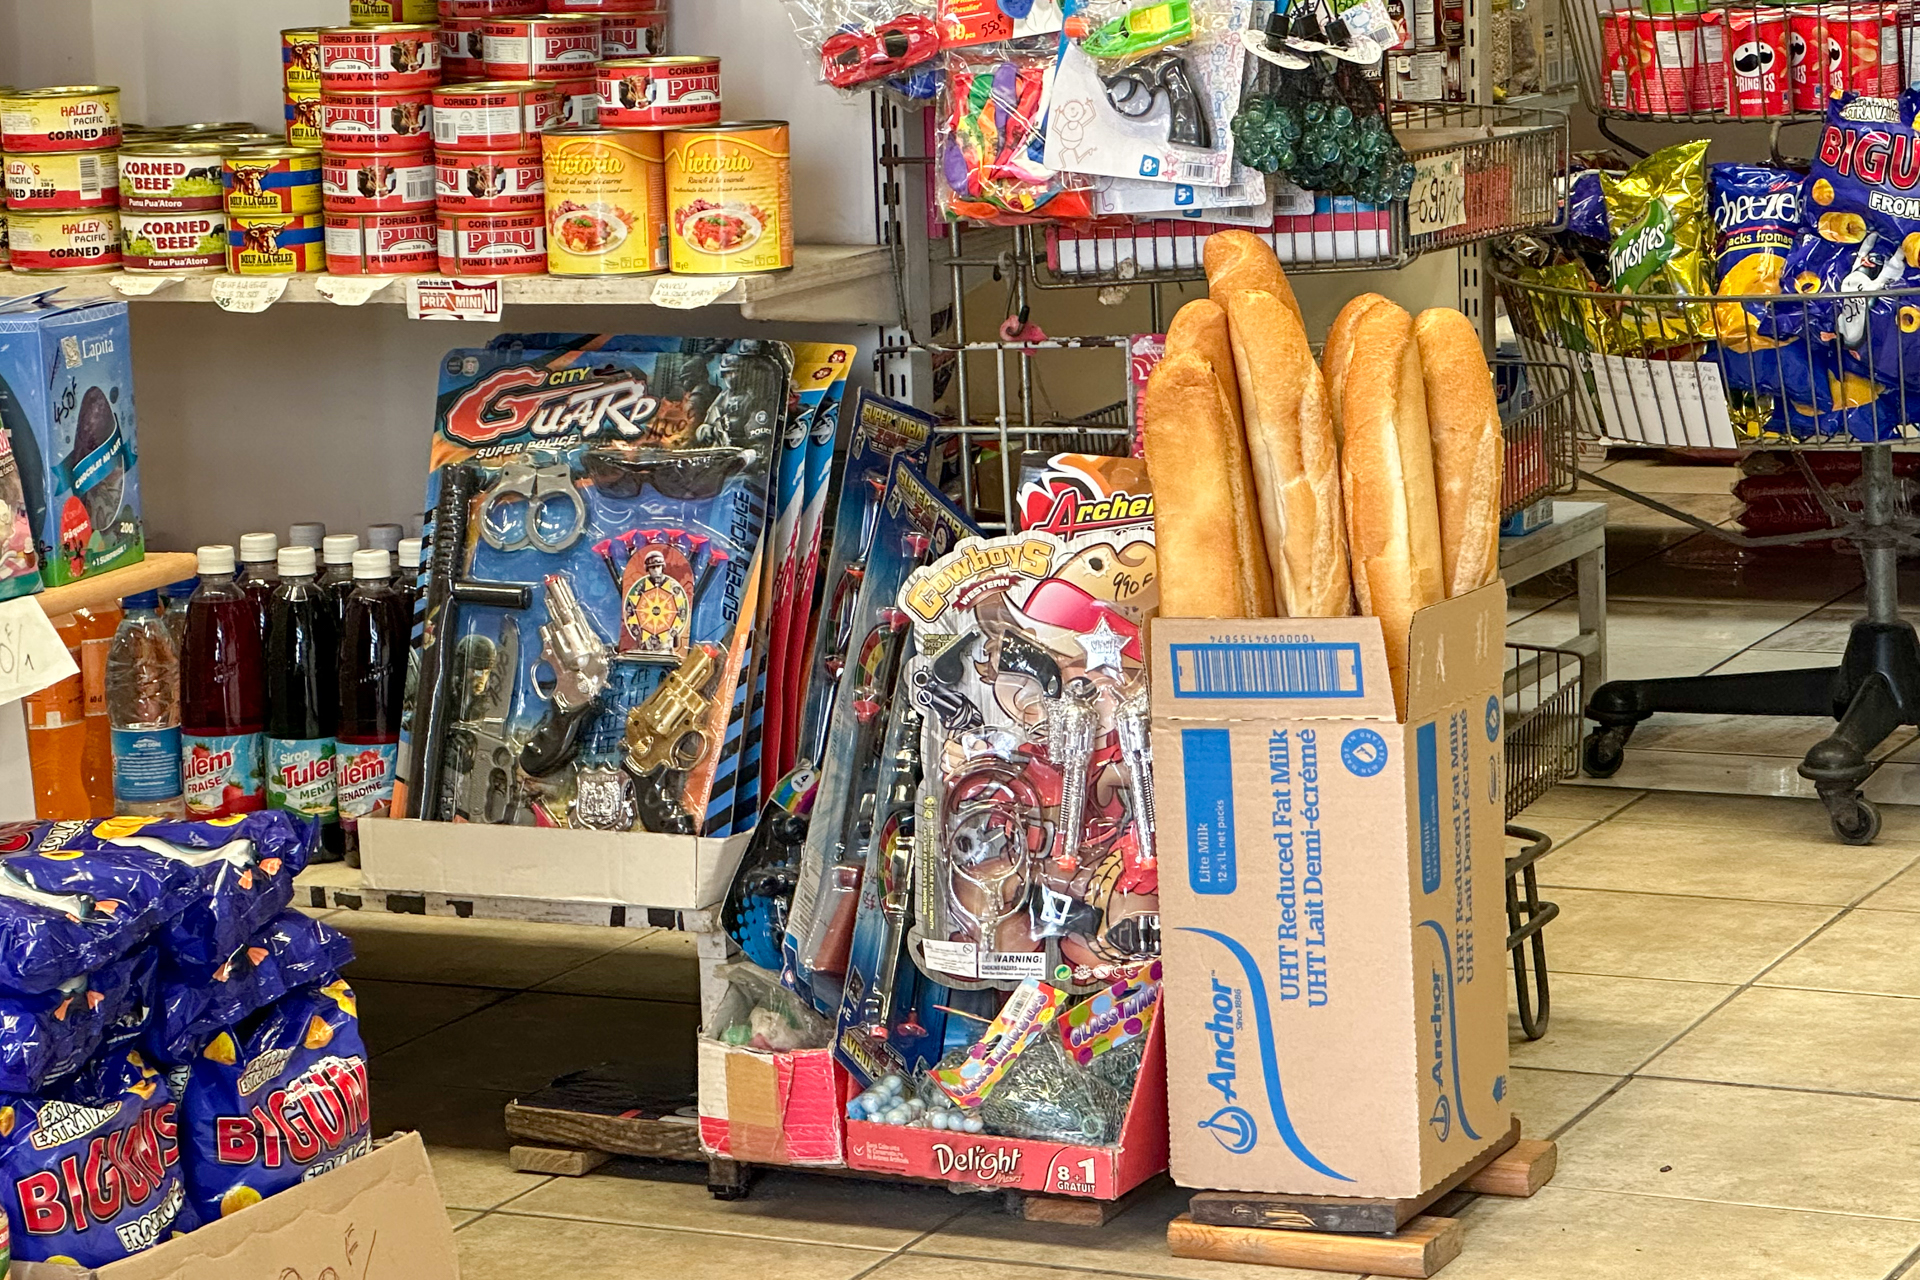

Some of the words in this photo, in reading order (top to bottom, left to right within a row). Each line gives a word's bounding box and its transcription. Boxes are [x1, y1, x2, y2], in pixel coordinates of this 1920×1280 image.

[547, 26, 584, 35] CORNED
[324, 47, 378, 63] PUNU
[549, 37, 599, 55] PUNU
[670, 76, 719, 96] PUNU
[61, 104, 98, 116] HALLEY
[355, 98, 380, 106] BEEF
[443, 98, 476, 106] CORNED
[480, 97, 506, 106] BEEF
[661, 106, 687, 115] PUNU
[74, 116, 103, 126] PACIFIC
[326, 108, 378, 124] PUNU
[48, 128, 98, 140] CORNED
[550, 146, 625, 175] Victoria
[674, 146, 754, 174] Victoria
[1143, 158, 1156, 173] 8+
[1820, 126, 1920, 190] BIGU
[125, 162, 186, 176] CORNED
[30, 188, 56, 198] BEEF
[134, 177, 172, 190] BEEF
[1178, 188, 1190, 202] 5+
[1870, 192, 1920, 218] FROM
[62, 222, 100, 234] HALLEY
[143, 220, 210, 236] CORNED
[380, 216, 418, 226] CORNED
[468, 220, 508, 228] CORNED
[511, 218, 534, 227] BEEF
[74, 234, 106, 244] PACIFIC
[156, 236, 198, 250] BEEF
[380, 226, 436, 246] PUNU
[469, 230, 533, 249] PUNU
[48, 246, 100, 258] CORNED
[148, 258, 168, 267] Punu
[462, 258, 486, 266] PUNU
[1609, 222, 1666, 286] Twisties
[422, 296, 447, 308] PRIX
[455, 296, 480, 308] MINI
[82, 338, 114, 362] Lapita
[549, 366, 590, 386] CITY
[476, 442, 522, 460] SUPER
[526, 434, 577, 450] POLICE
[120, 522, 134, 534] 200
[722, 559, 744, 626] SUPER
[959, 577, 1010, 606] WESTERN
[1113, 572, 1139, 601] 990
[1448, 712, 1460, 768] Milk
[280, 750, 310, 765] Sirop
[1268, 729, 1292, 783] Milk
[337, 757, 384, 788] ulem
[188, 776, 222, 794] FRAISE
[300, 776, 337, 800] MENTH
[338, 781, 382, 803] RENADINE
[1450, 772, 1462, 812] Fat
[1457, 708, 1473, 876] Demi-écrémé
[1216, 800, 1228, 828] packs
[1272, 788, 1293, 828] Fat
[1296, 728, 1325, 896] Demi-écrémé
[1197, 822, 1210, 854] Milk
[1217, 832, 1226, 848] net
[1217, 851, 1226, 862] 1L
[1199, 856, 1211, 883] Lite
[1217, 872, 1228, 883] 12
[1452, 816, 1464, 923] Reduced
[1272, 832, 1299, 942] Reduced
[1464, 880, 1474, 923] Lait
[1305, 898, 1326, 946] Lait
[1455, 928, 1466, 986] UHT
[1464, 929, 1475, 986] UHT
[1280, 950, 1301, 1002] UHT
[1308, 952, 1330, 1008] UHT
[1070, 1006, 1120, 1048] GLASS
[1430, 966, 1444, 1090] Anchor
[950, 1063, 994, 1097] GLASS
[993, 992, 1050, 1063] MARBLES
[1204, 978, 1238, 1105] Anchor
[216, 1055, 371, 1168] BIGUN
[932, 1143, 1023, 1180] Delight
[1057, 1182, 1096, 1194] GRATUIT
